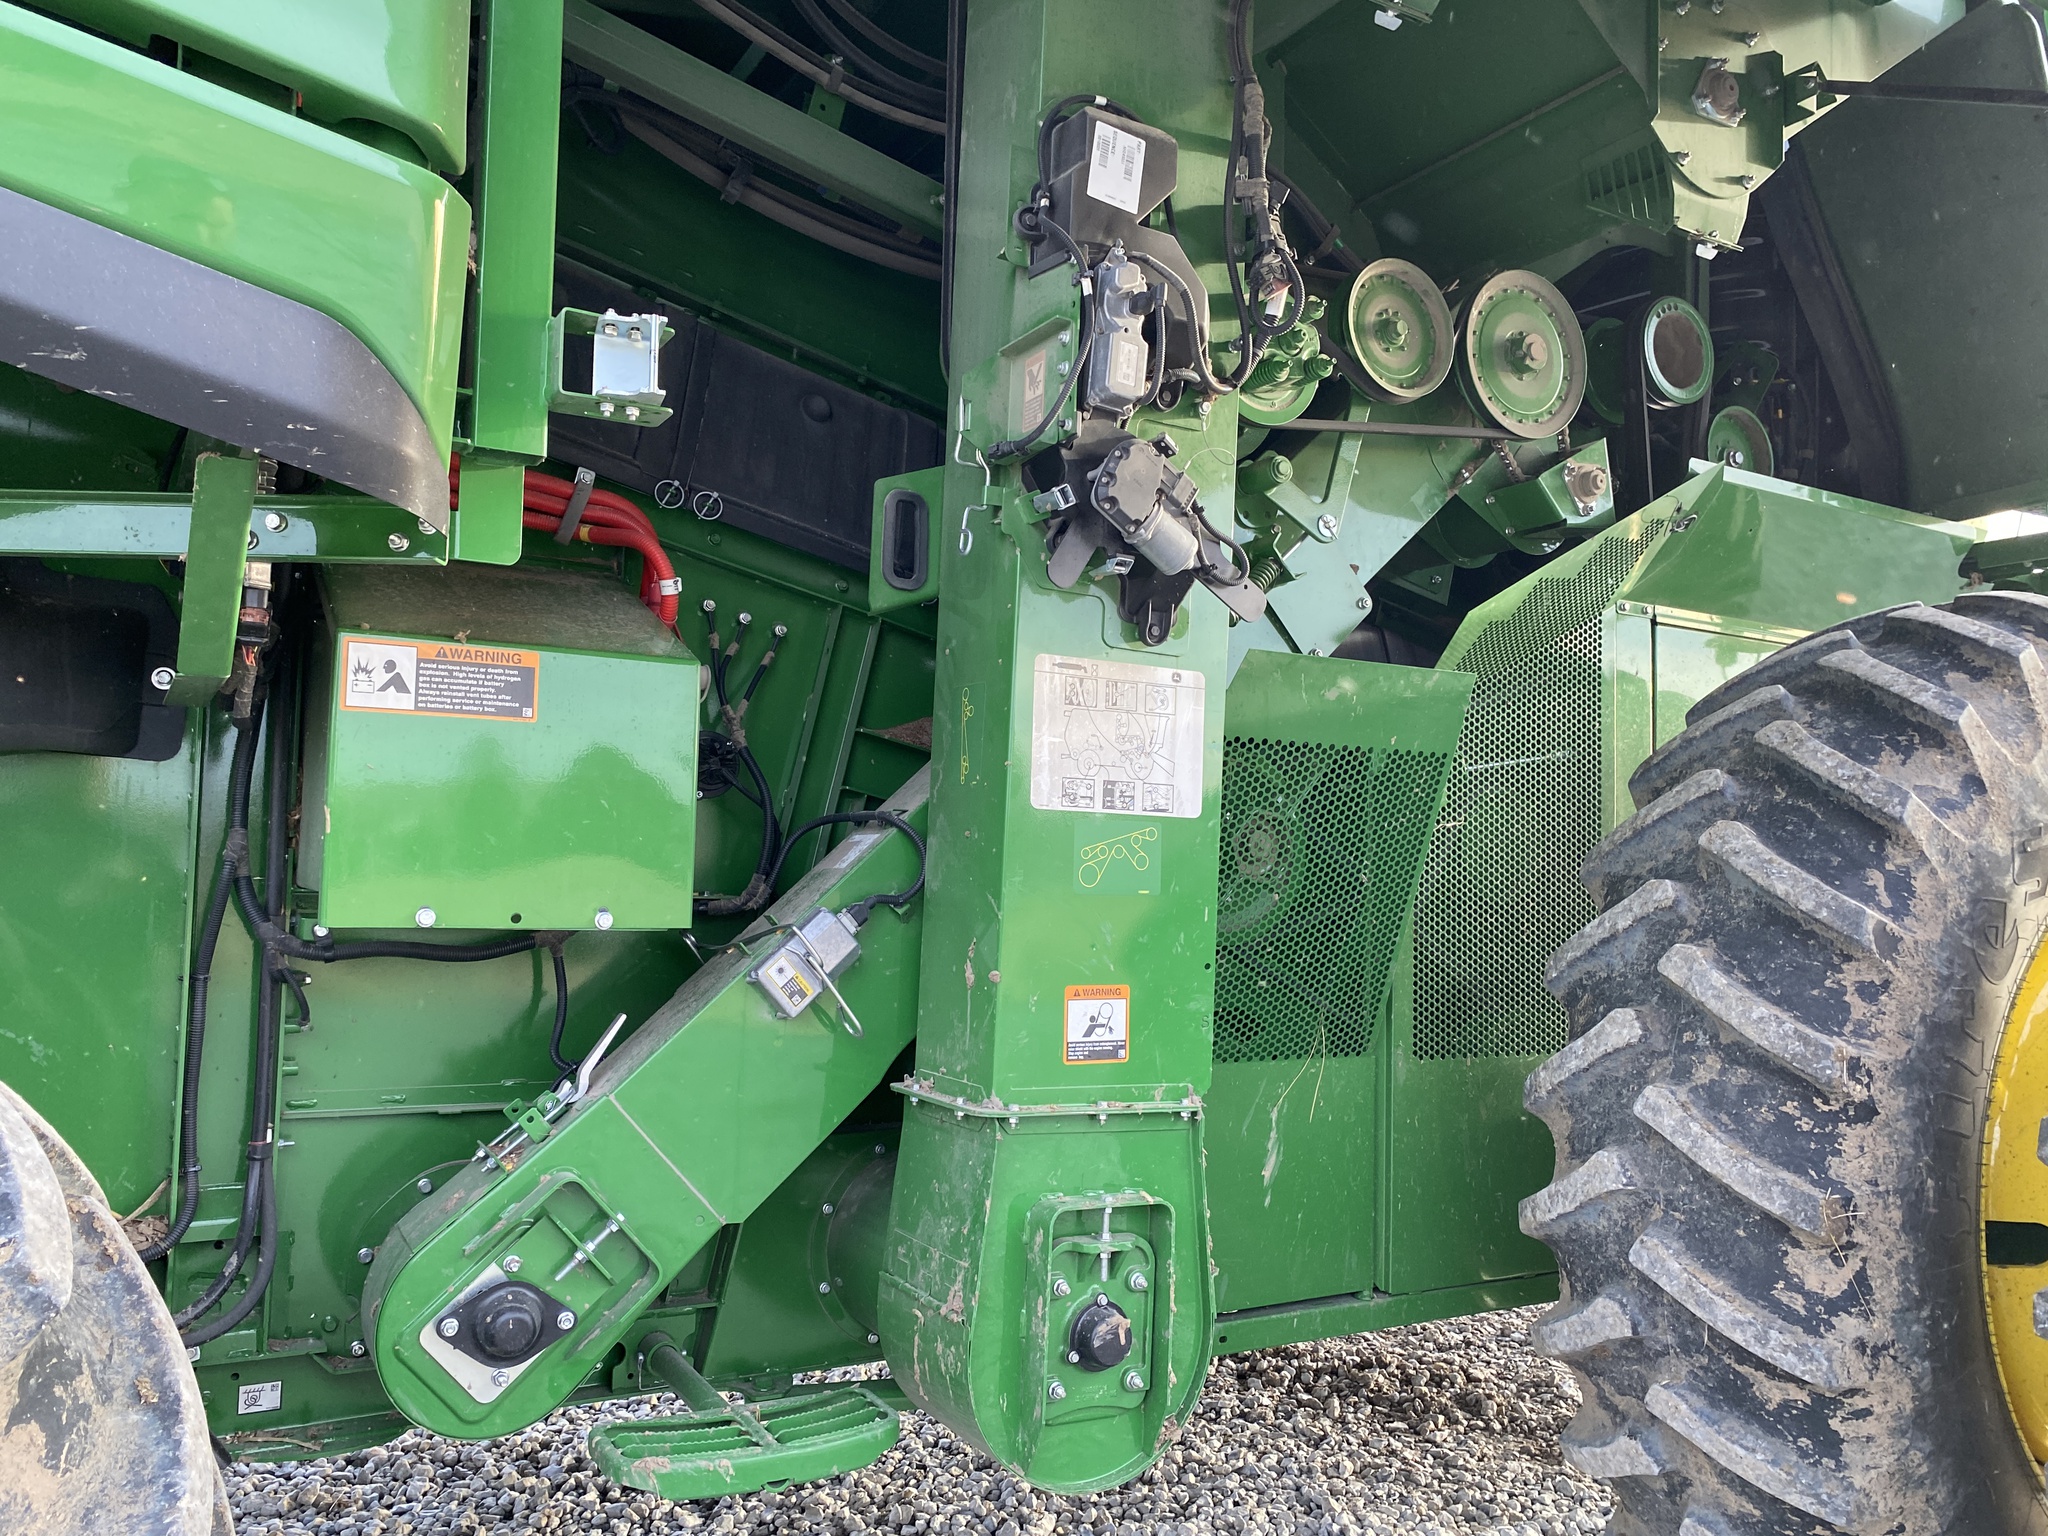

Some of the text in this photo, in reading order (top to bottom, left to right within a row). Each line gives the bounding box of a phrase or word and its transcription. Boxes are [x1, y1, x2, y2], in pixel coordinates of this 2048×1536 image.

[450, 648, 522, 664] WARNING
[494, 674, 522, 682] hydrogen
[484, 680, 505, 688] battery
[418, 688, 440, 696] Always
[417, 696, 451, 704] performing
[462, 705, 483, 713] battery
[1082, 988, 1122, 997] WARNING
